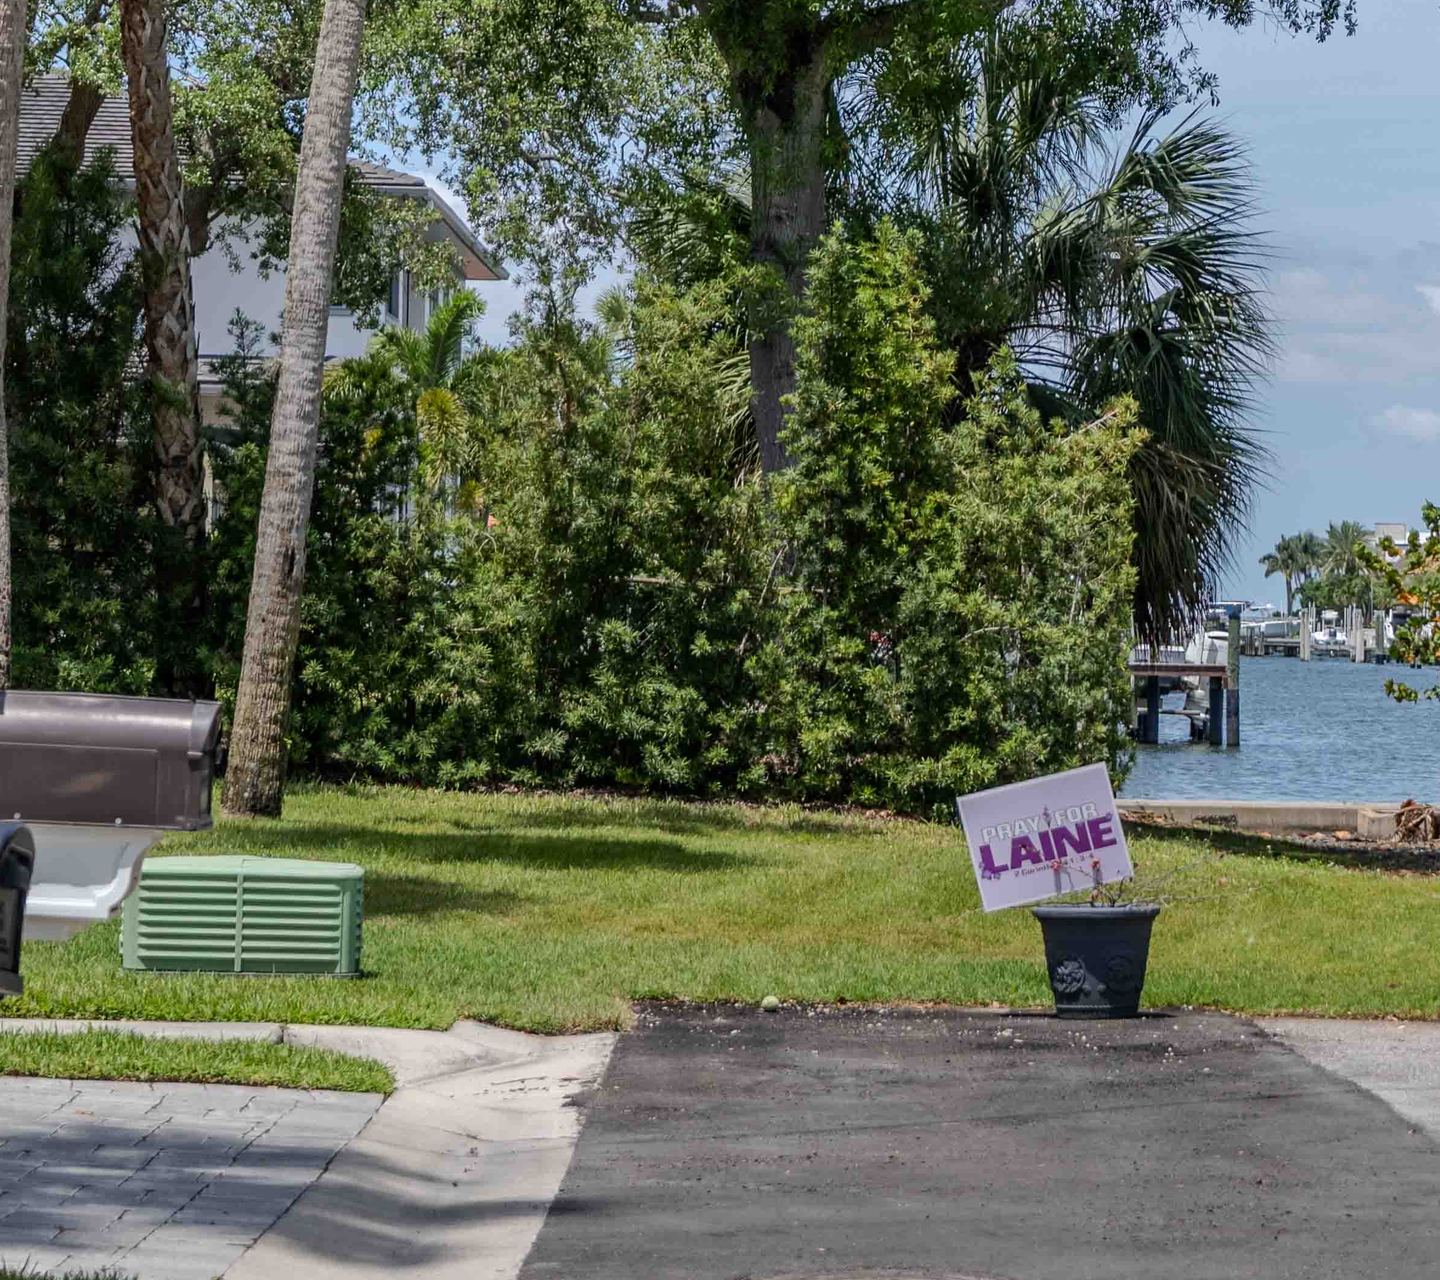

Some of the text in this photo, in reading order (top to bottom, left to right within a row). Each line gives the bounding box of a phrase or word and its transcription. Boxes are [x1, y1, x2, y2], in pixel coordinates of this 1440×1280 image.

[980, 814, 1117, 873] LAINE
[981, 802, 1098, 842] PRAY FOR
